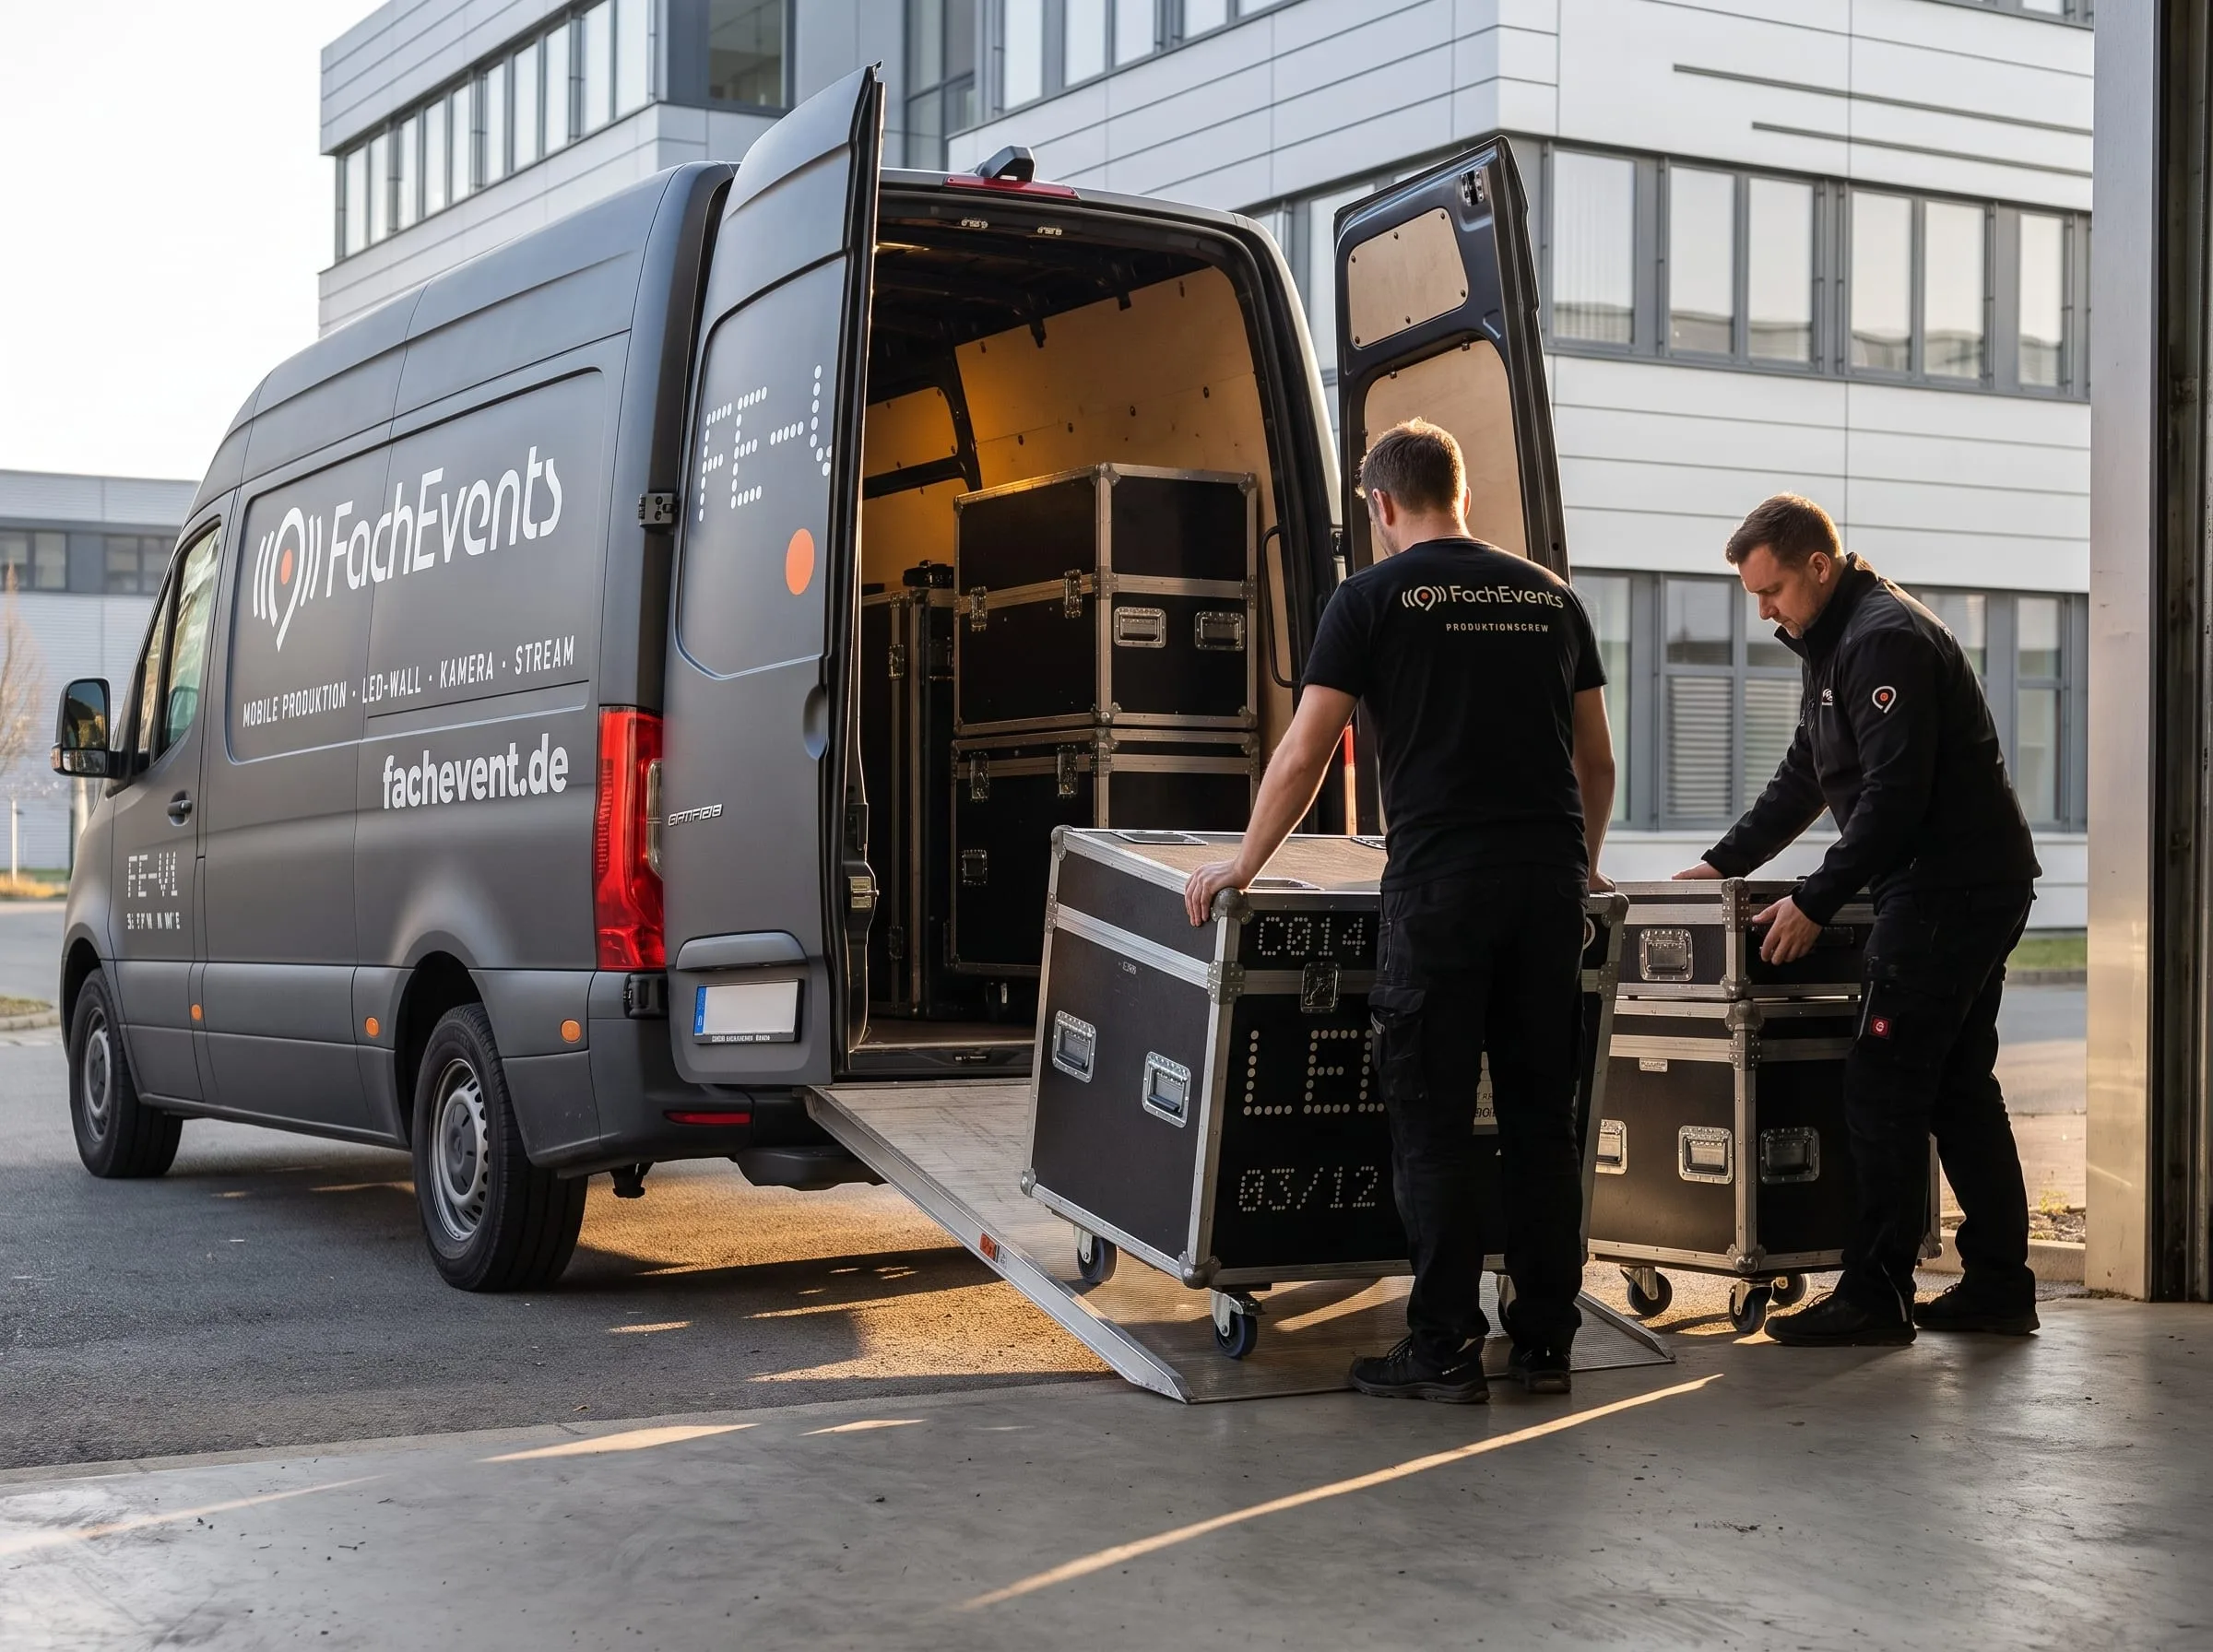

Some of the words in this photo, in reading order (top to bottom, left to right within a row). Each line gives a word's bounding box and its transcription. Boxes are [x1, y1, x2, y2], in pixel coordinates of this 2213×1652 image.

[325, 445, 562, 598] FachEvents
[1445, 622, 1549, 632] PRODUKTIONSCREW
[1449, 585, 1564, 608] FachEvents
[243, 696, 278, 728] MOBILE
[282, 681, 347, 718] PRODUKTION
[361, 666, 421, 704] LED-WALL
[440, 651, 494, 690] KAMERA
[515, 635, 575, 676] STREAM
[383, 732, 569, 809] fachevent.de
[1238, 1165, 1379, 1212] 03/12
